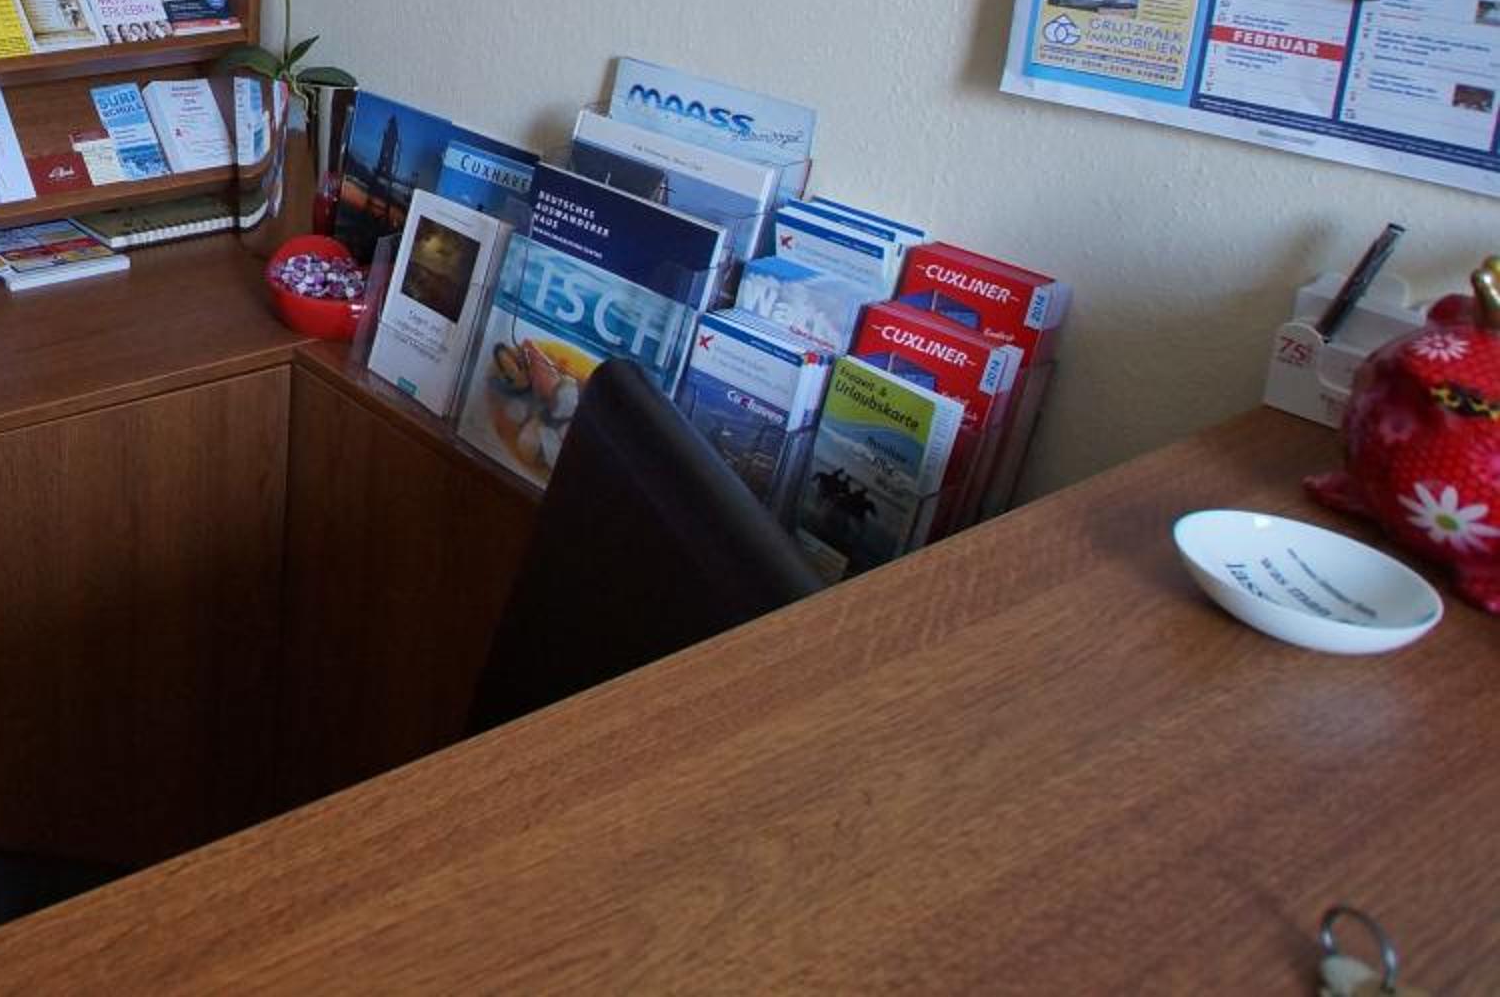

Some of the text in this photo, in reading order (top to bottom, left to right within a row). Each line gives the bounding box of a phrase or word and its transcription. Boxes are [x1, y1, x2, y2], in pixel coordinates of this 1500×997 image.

[1232, 29, 1320, 56] FEBRUAR
[459, 153, 533, 193] CUXHAVE
[532, 212, 560, 231] HAUS
[535, 203, 611, 239] AUSWANDERER
[537, 189, 597, 219] DEUTSCHES
[923, 263, 1012, 305] CUXLINER
[879, 324, 968, 367] CUXLINER
[833, 380, 920, 432] Urlaubskarte
